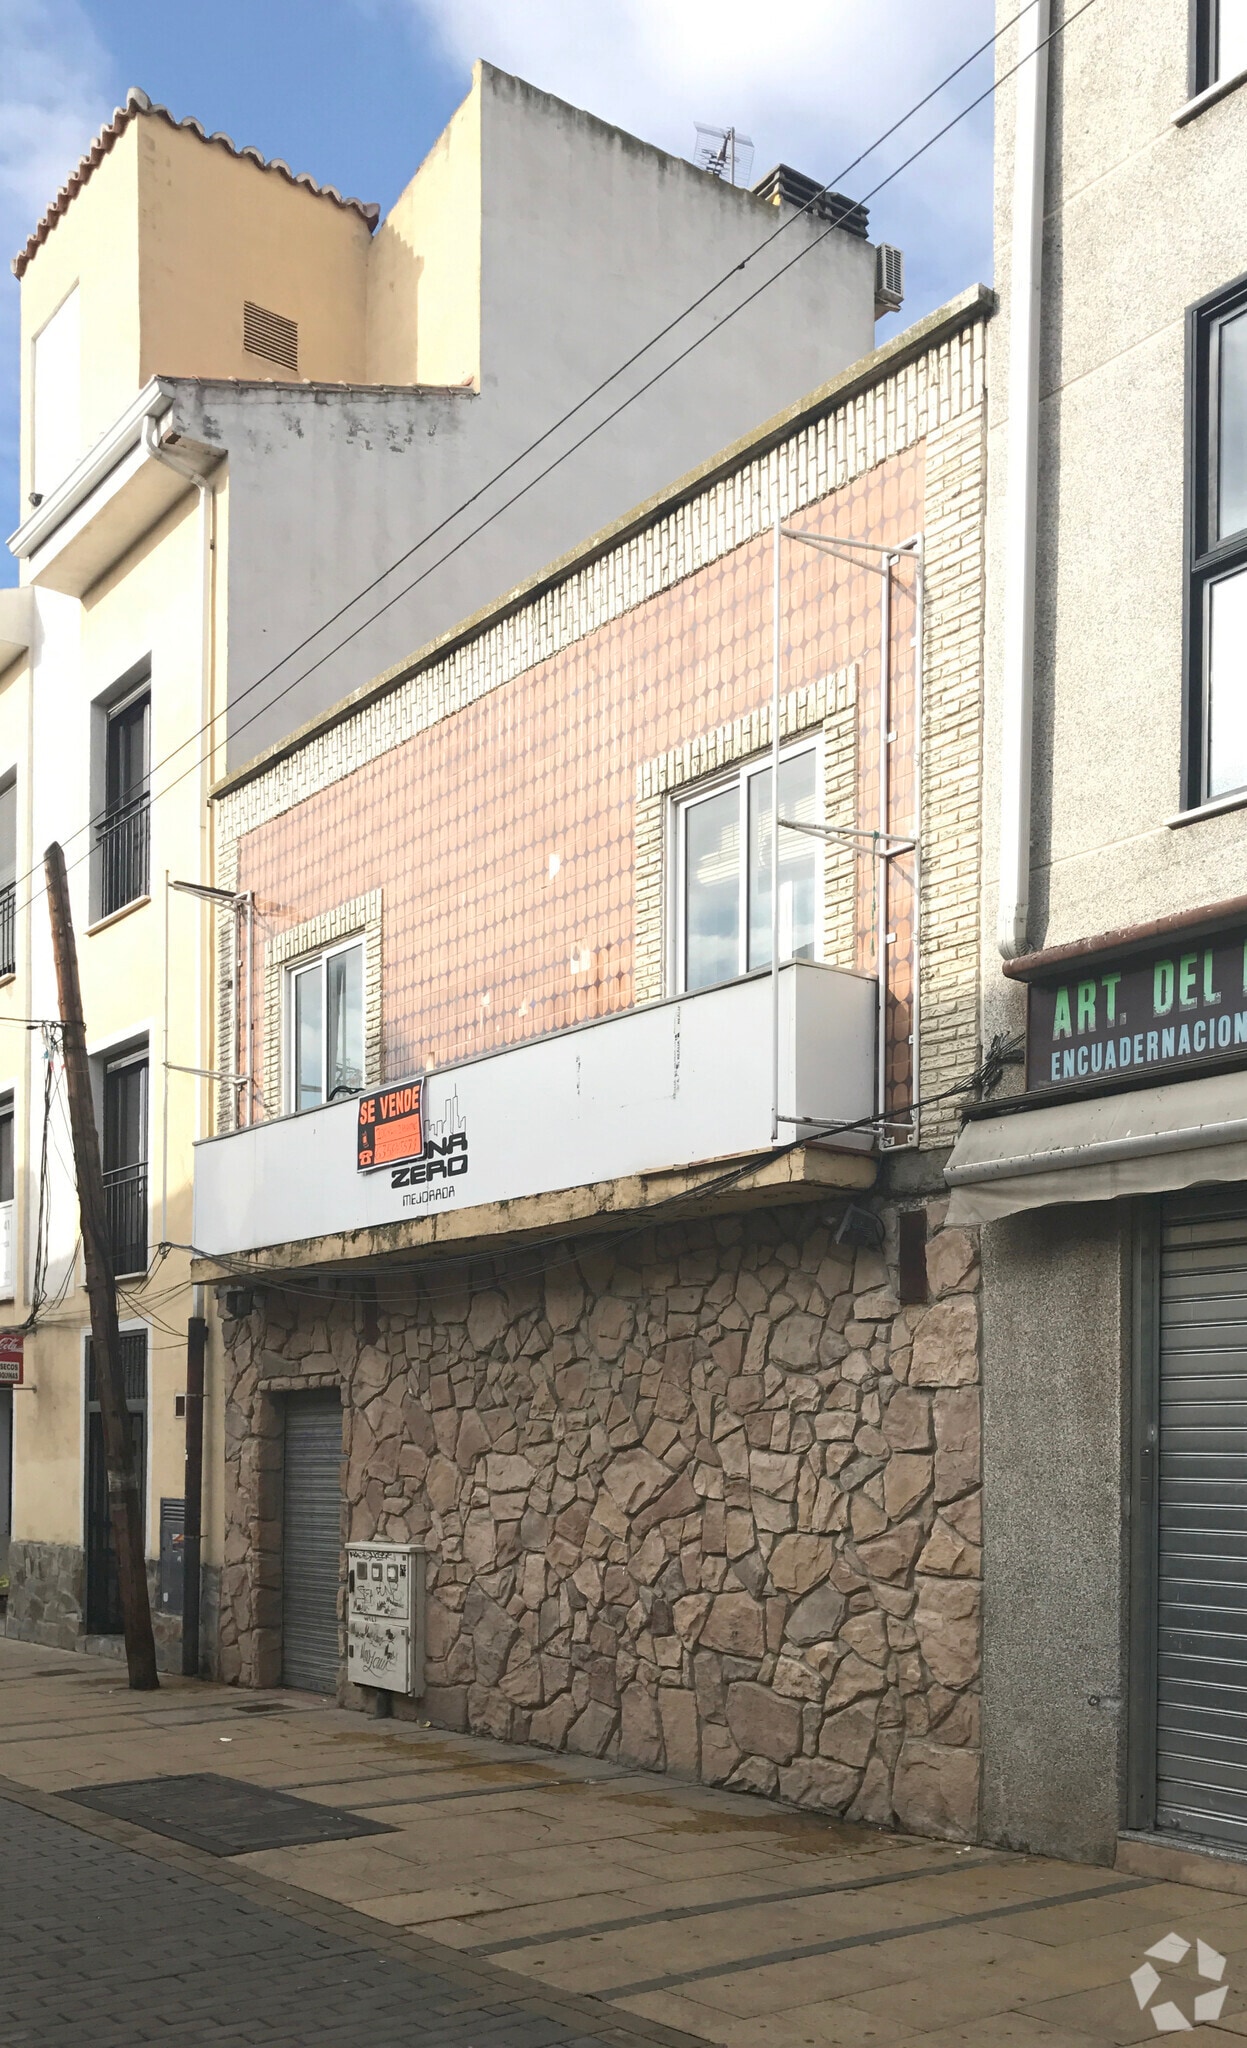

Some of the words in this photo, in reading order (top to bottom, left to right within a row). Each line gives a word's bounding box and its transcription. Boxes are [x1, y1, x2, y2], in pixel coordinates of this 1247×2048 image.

[1052, 971, 1127, 1041] ART.
[1153, 949, 1221, 1018] DEL
[360, 1099, 376, 1125] SE
[380, 1085, 420, 1119] VENDE
[391, 1154, 468, 1189] ZERO
[402, 1186, 455, 1207] MEJORADA
